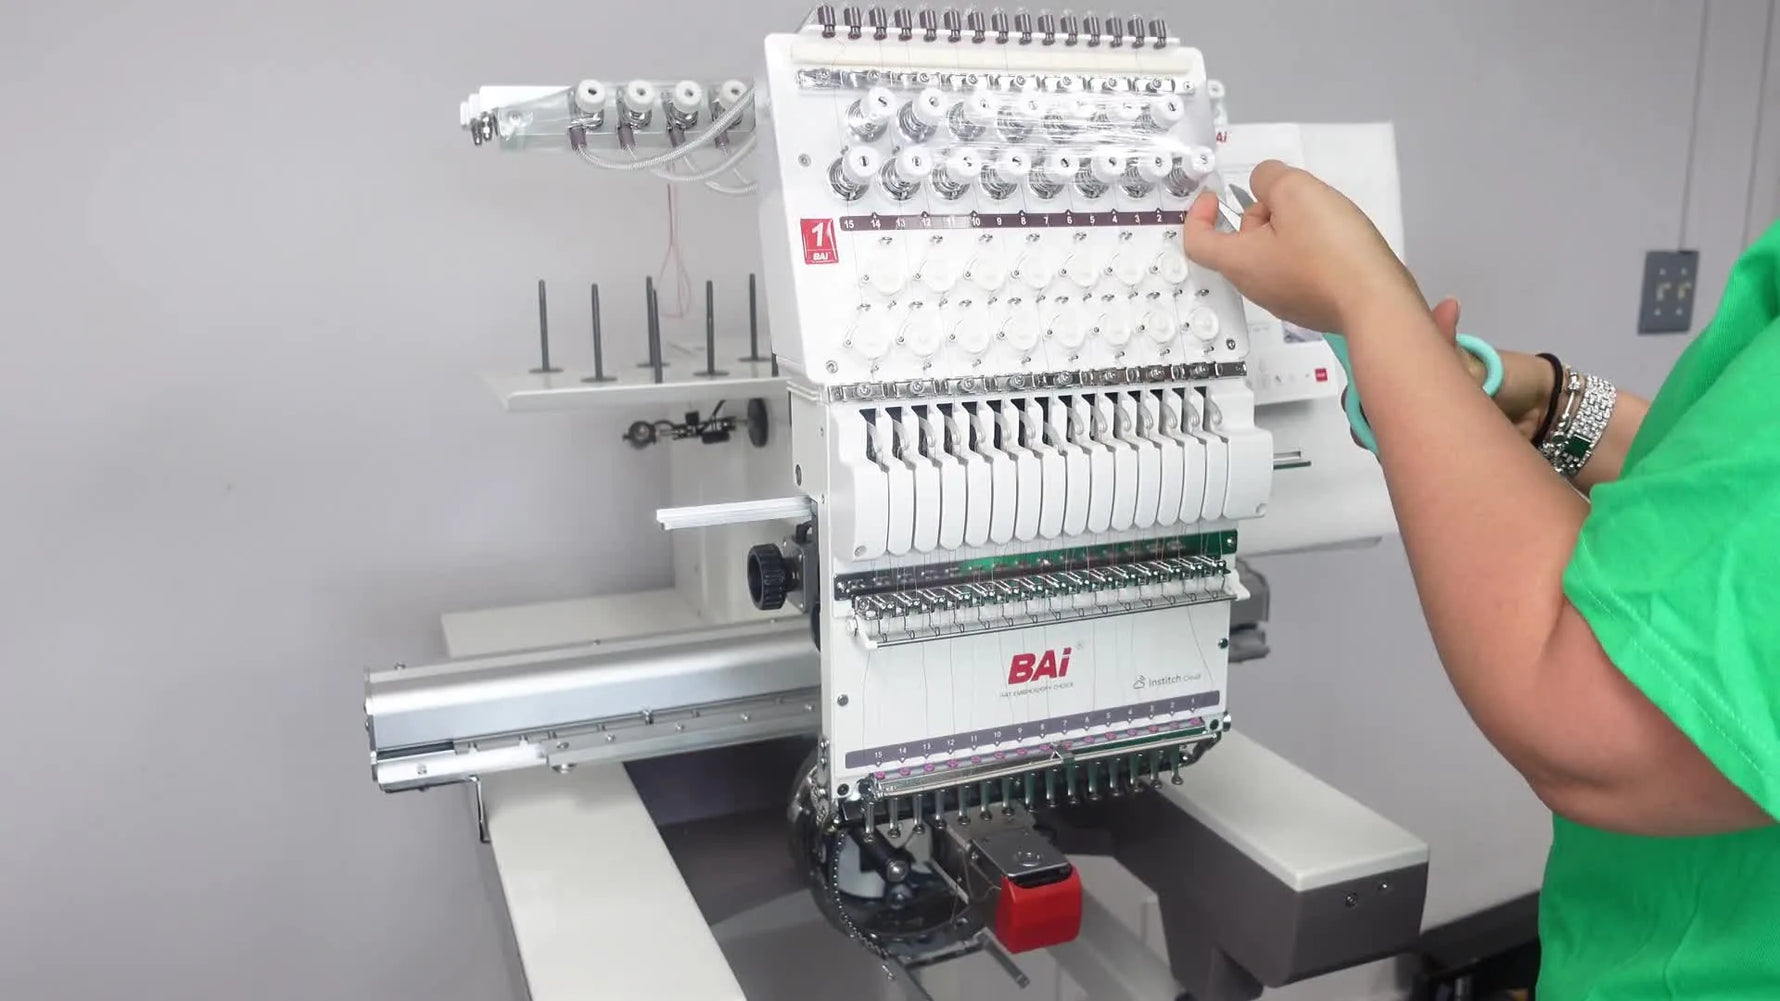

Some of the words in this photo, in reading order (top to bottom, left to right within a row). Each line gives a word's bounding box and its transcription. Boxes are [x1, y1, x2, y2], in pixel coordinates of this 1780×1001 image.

[844, 220, 855, 229] 15
[871, 219, 880, 228] 14
[896, 218, 906, 227] 13
[922, 218, 931, 227] 12
[972, 217, 981, 226] 10
[996, 217, 1002, 226] 9
[1021, 216, 1027, 225] 8
[1067, 215, 1073, 224] 6
[1112, 214, 1118, 223] 4
[1156, 214, 1162, 223] 2
[811, 222, 824, 247] 1
[1149, 673, 1182, 687] Institch
